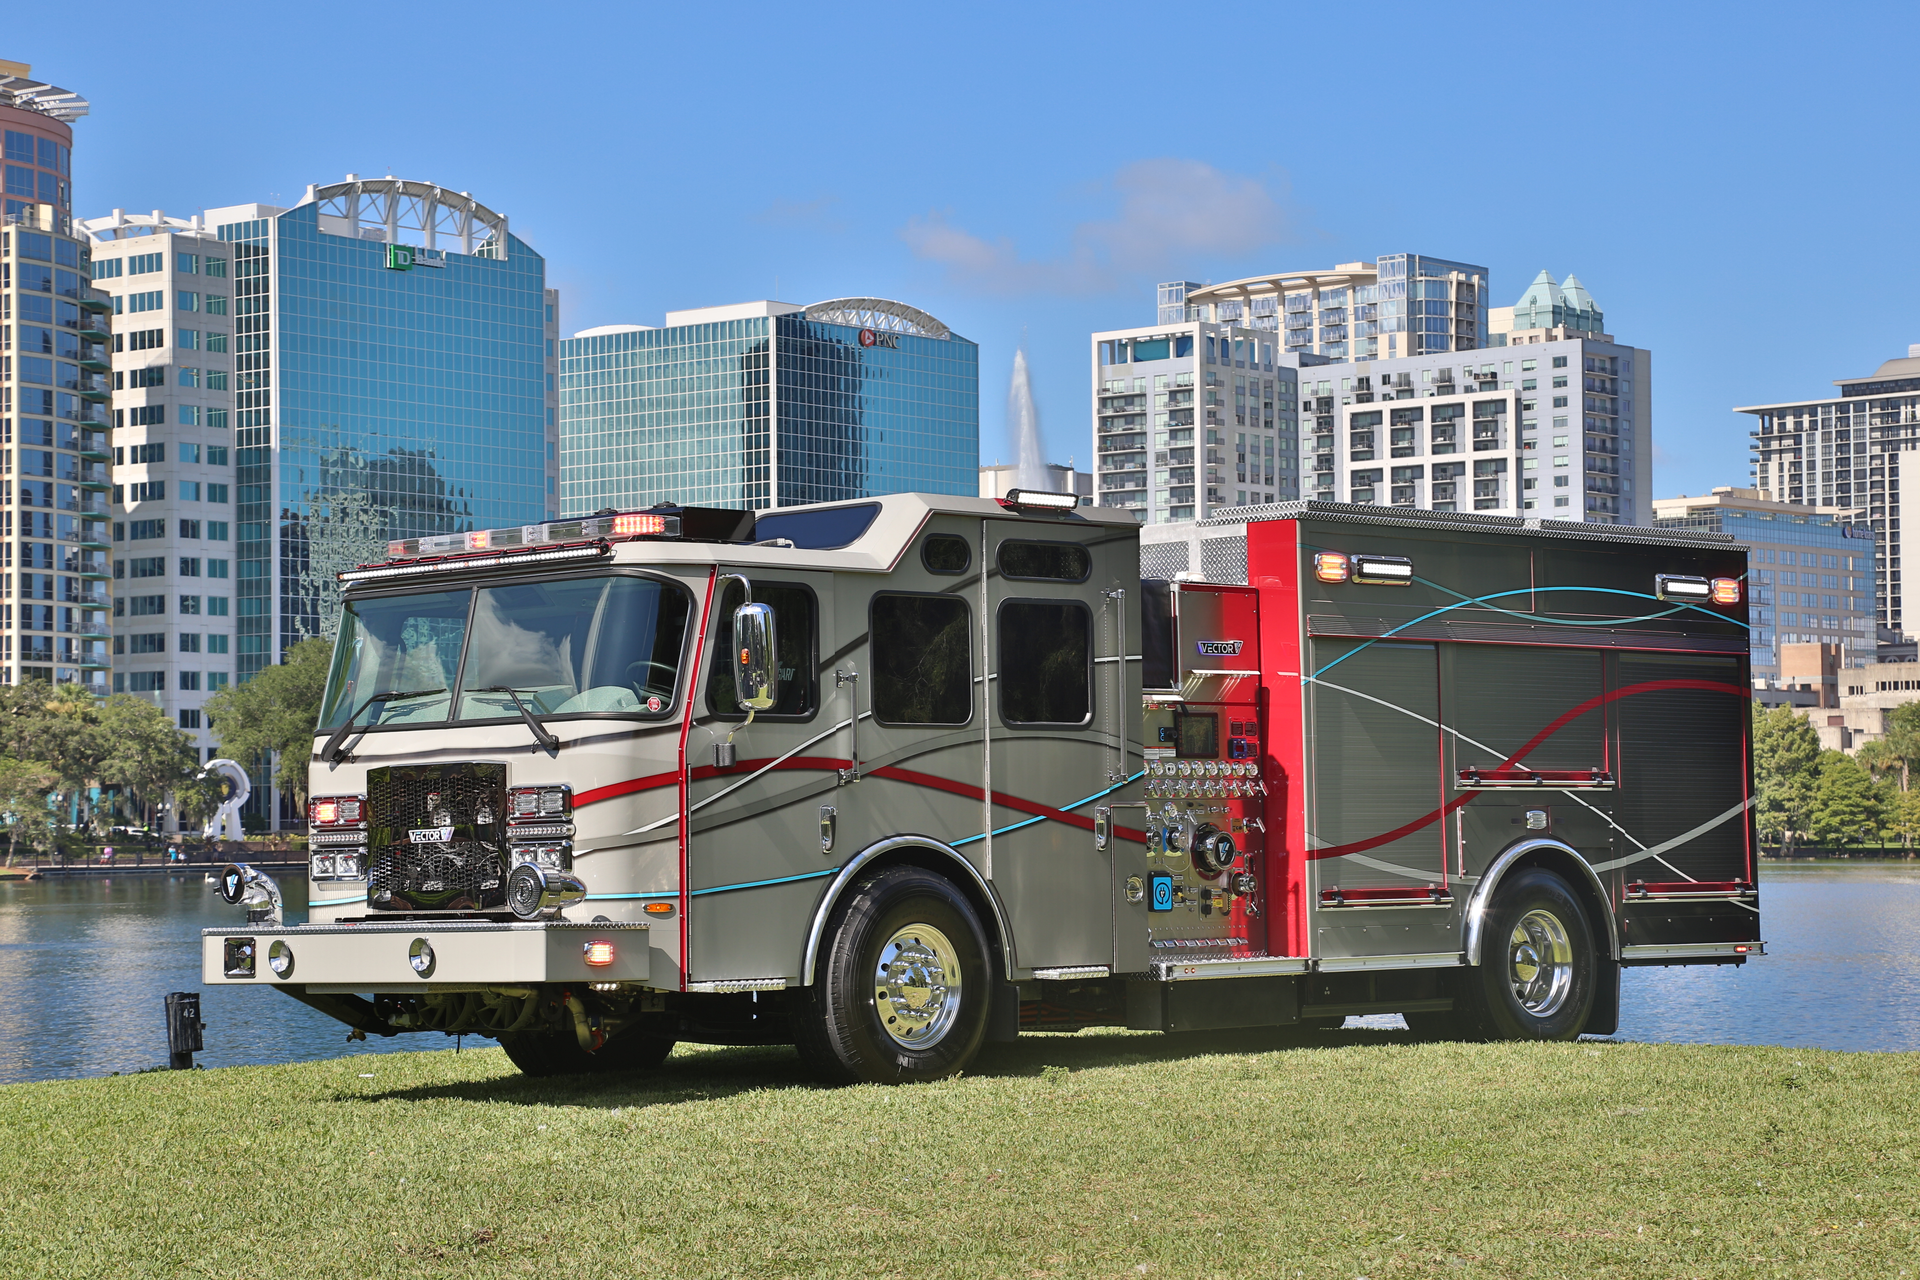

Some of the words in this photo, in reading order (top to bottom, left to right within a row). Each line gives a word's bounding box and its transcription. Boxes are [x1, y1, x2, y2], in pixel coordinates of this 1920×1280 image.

[394, 249, 411, 266] TD
[415, 254, 446, 268] Bank
[876, 332, 901, 349] PNC
[1201, 643, 1234, 654] VECTOR
[410, 831, 441, 841] VECTOR
[183, 1008, 195, 1018] 42
